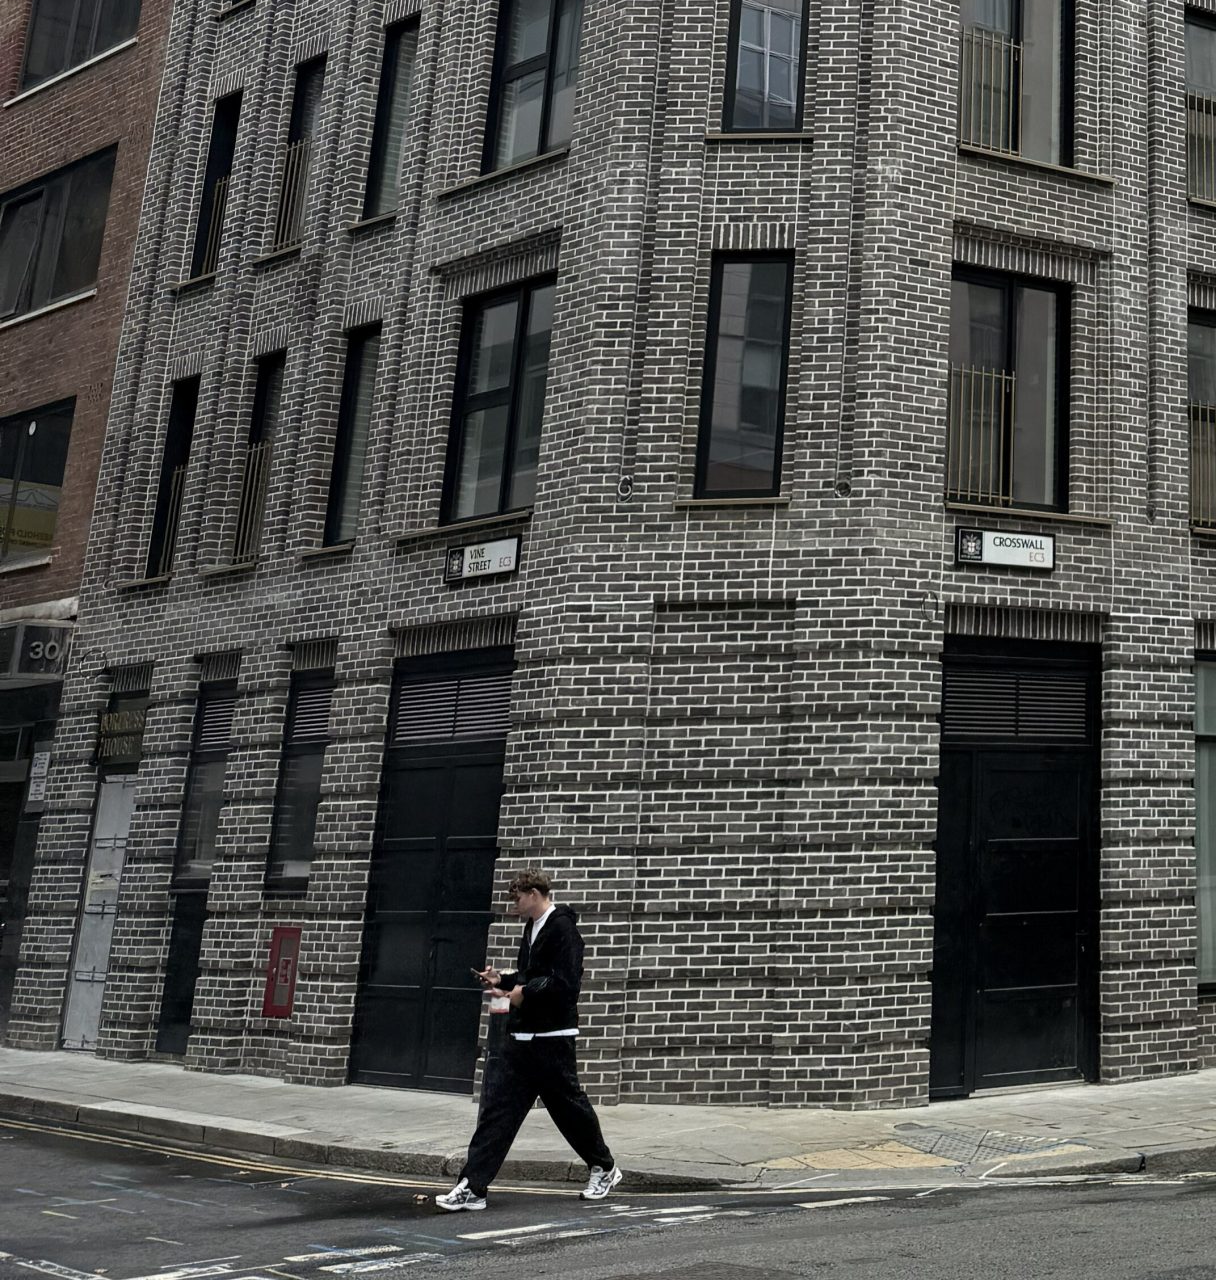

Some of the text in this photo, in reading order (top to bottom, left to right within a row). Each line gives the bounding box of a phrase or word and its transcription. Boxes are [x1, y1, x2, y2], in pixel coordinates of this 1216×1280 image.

[993, 536, 1045, 550] CROSSWALL
[470, 547, 486, 560] VINE
[1029, 551, 1045, 563] EC3
[468, 559, 491, 572] STREET
[498, 556, 512, 568] EC3
[30, 641, 60, 660] 30
